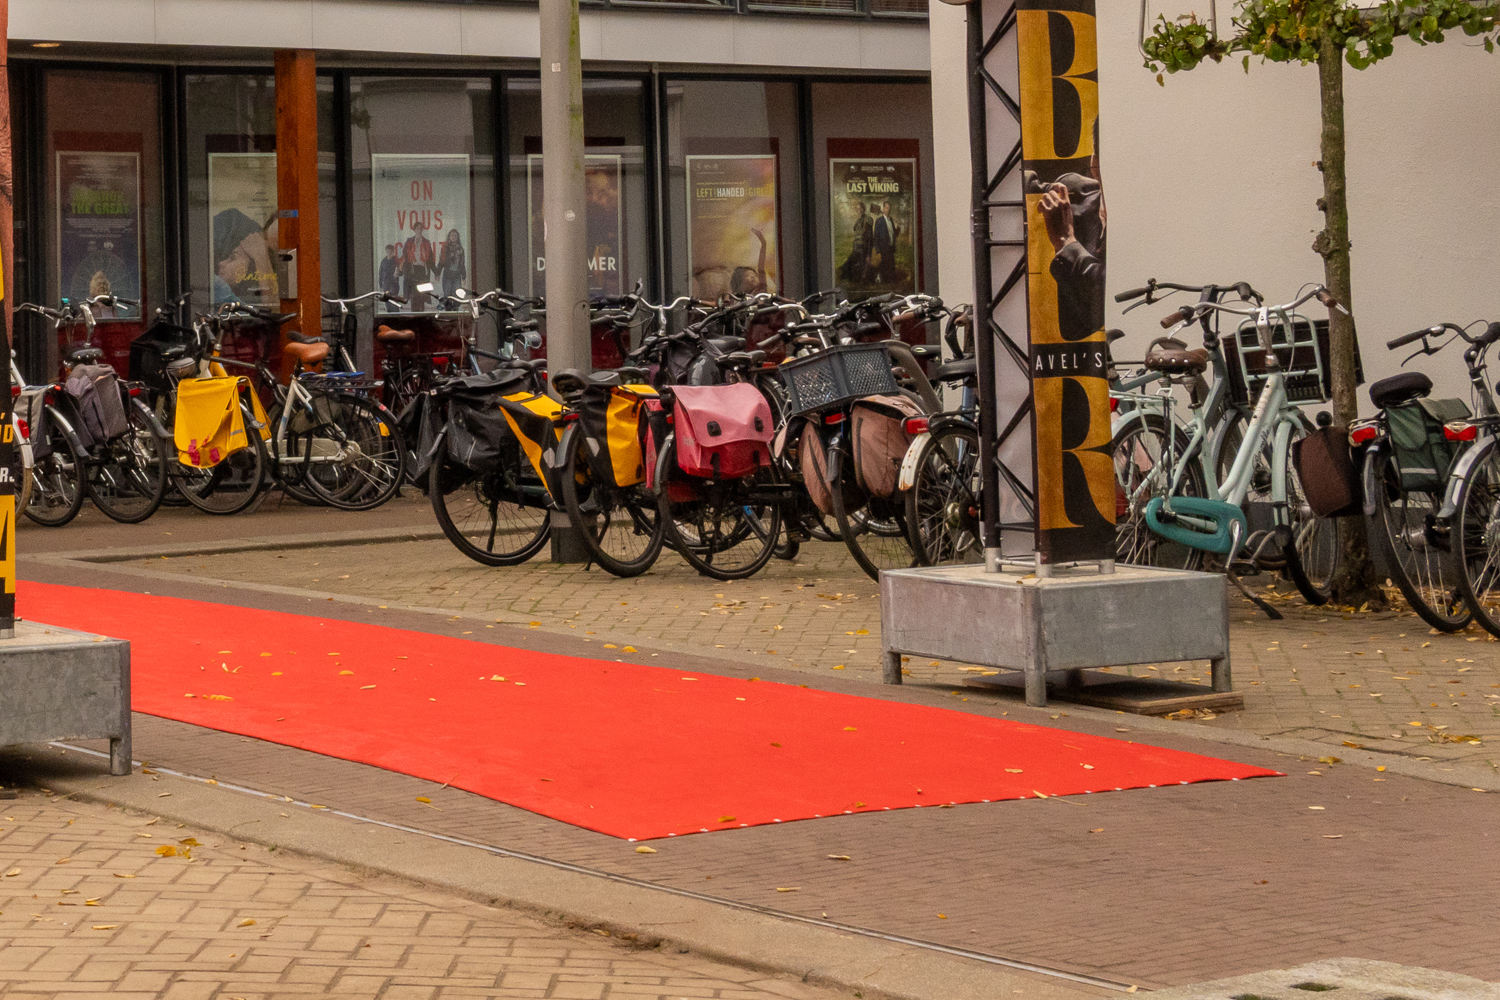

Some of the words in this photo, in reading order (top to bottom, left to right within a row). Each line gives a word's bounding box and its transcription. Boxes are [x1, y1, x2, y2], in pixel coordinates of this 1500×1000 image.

[411, 180, 433, 201] ON
[716, 187, 745, 198] HANDED
[846, 182, 867, 193] LAST
[868, 182, 899, 193] VIKING
[397, 209, 444, 231] VOUS
[394, 241, 448, 264] CROIT
[1035, 352, 1103, 371] AVEL'S
